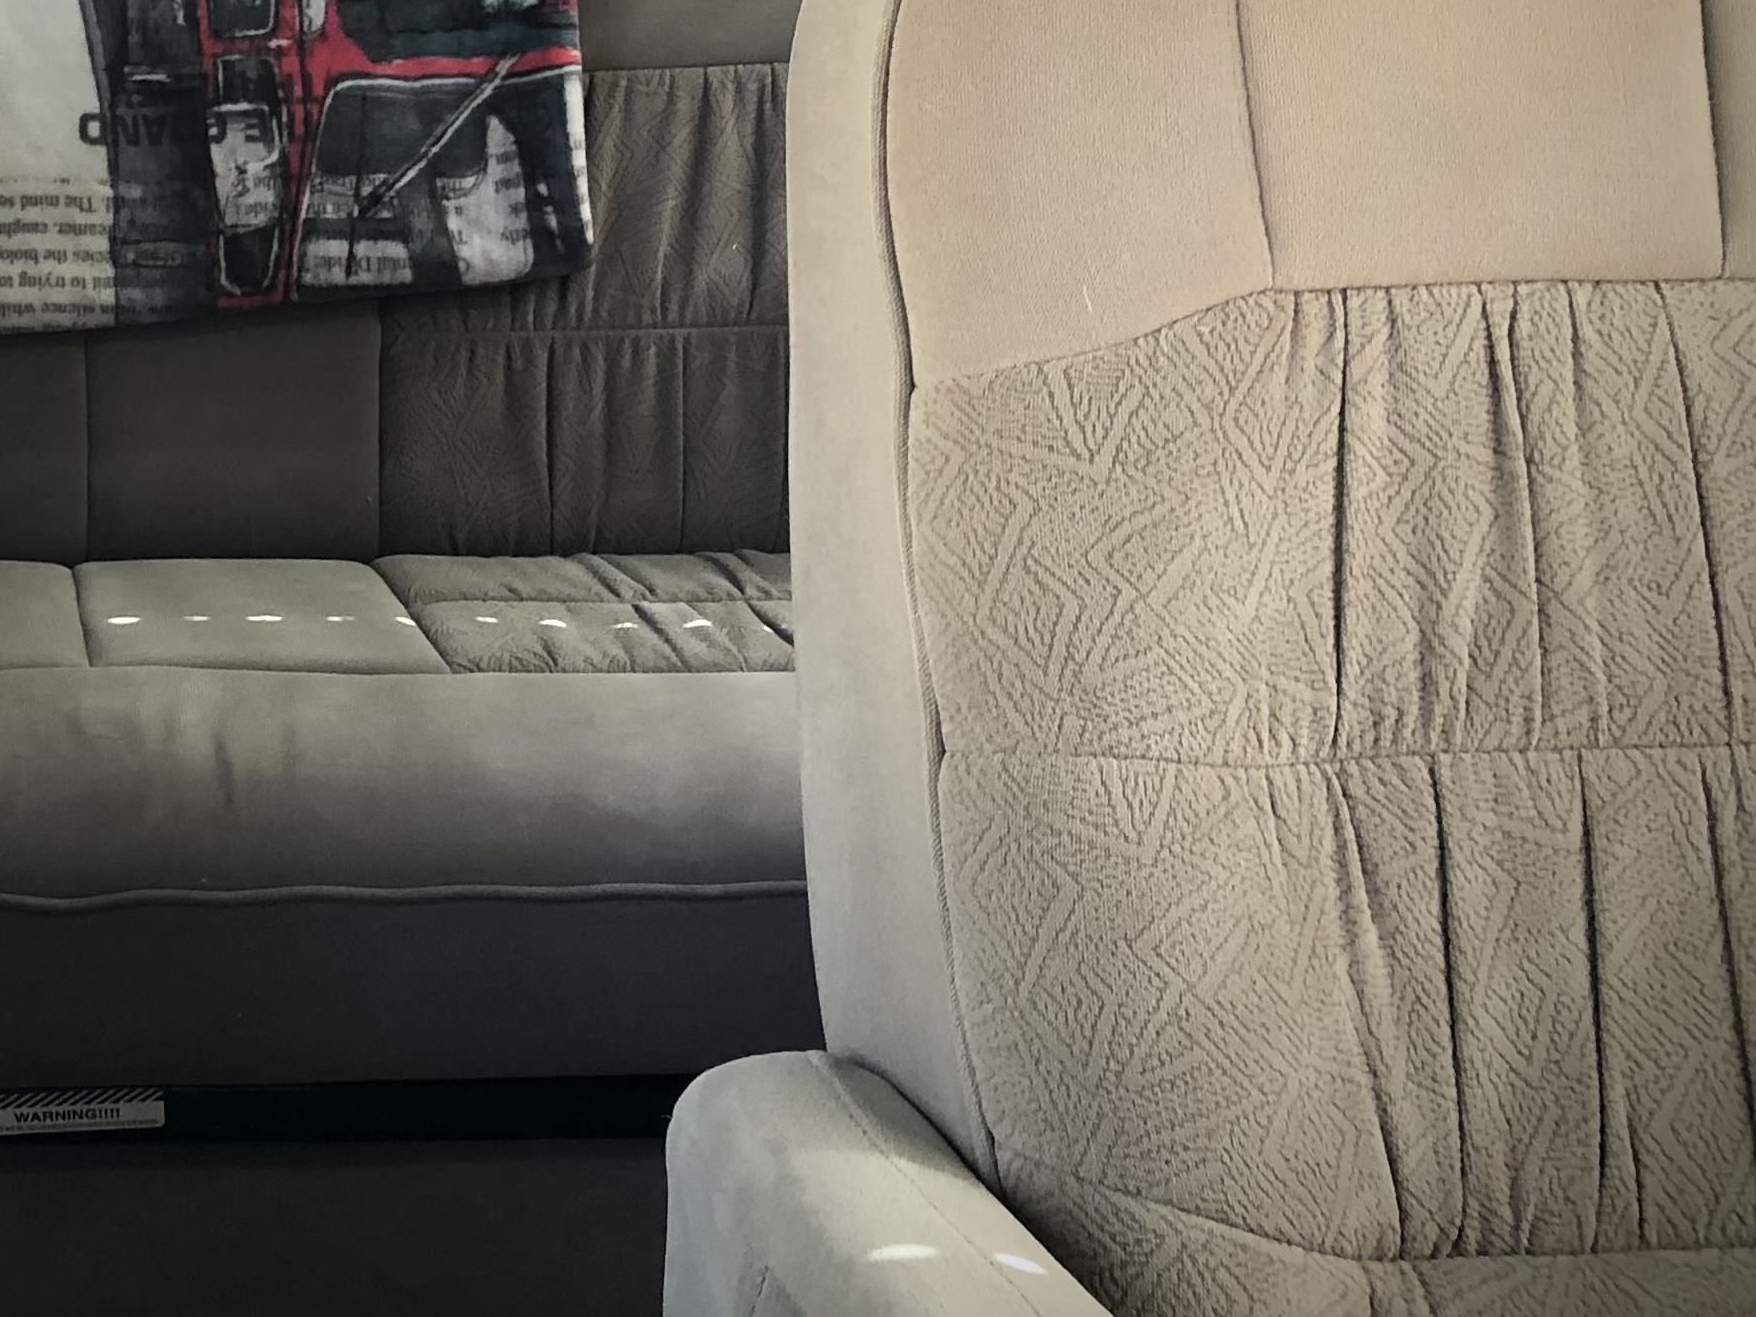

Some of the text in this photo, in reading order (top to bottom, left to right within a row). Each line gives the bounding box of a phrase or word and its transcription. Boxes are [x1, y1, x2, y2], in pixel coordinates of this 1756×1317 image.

[19, 195, 60, 213] mind
[65, 195, 97, 214] The
[0, 219, 48, 239] caught
[43, 250, 67, 265] the
[0, 275, 13, 289] to
[19, 272, 65, 291] trying
[71, 276, 85, 290] to
[41, 302, 95, 319] silence
